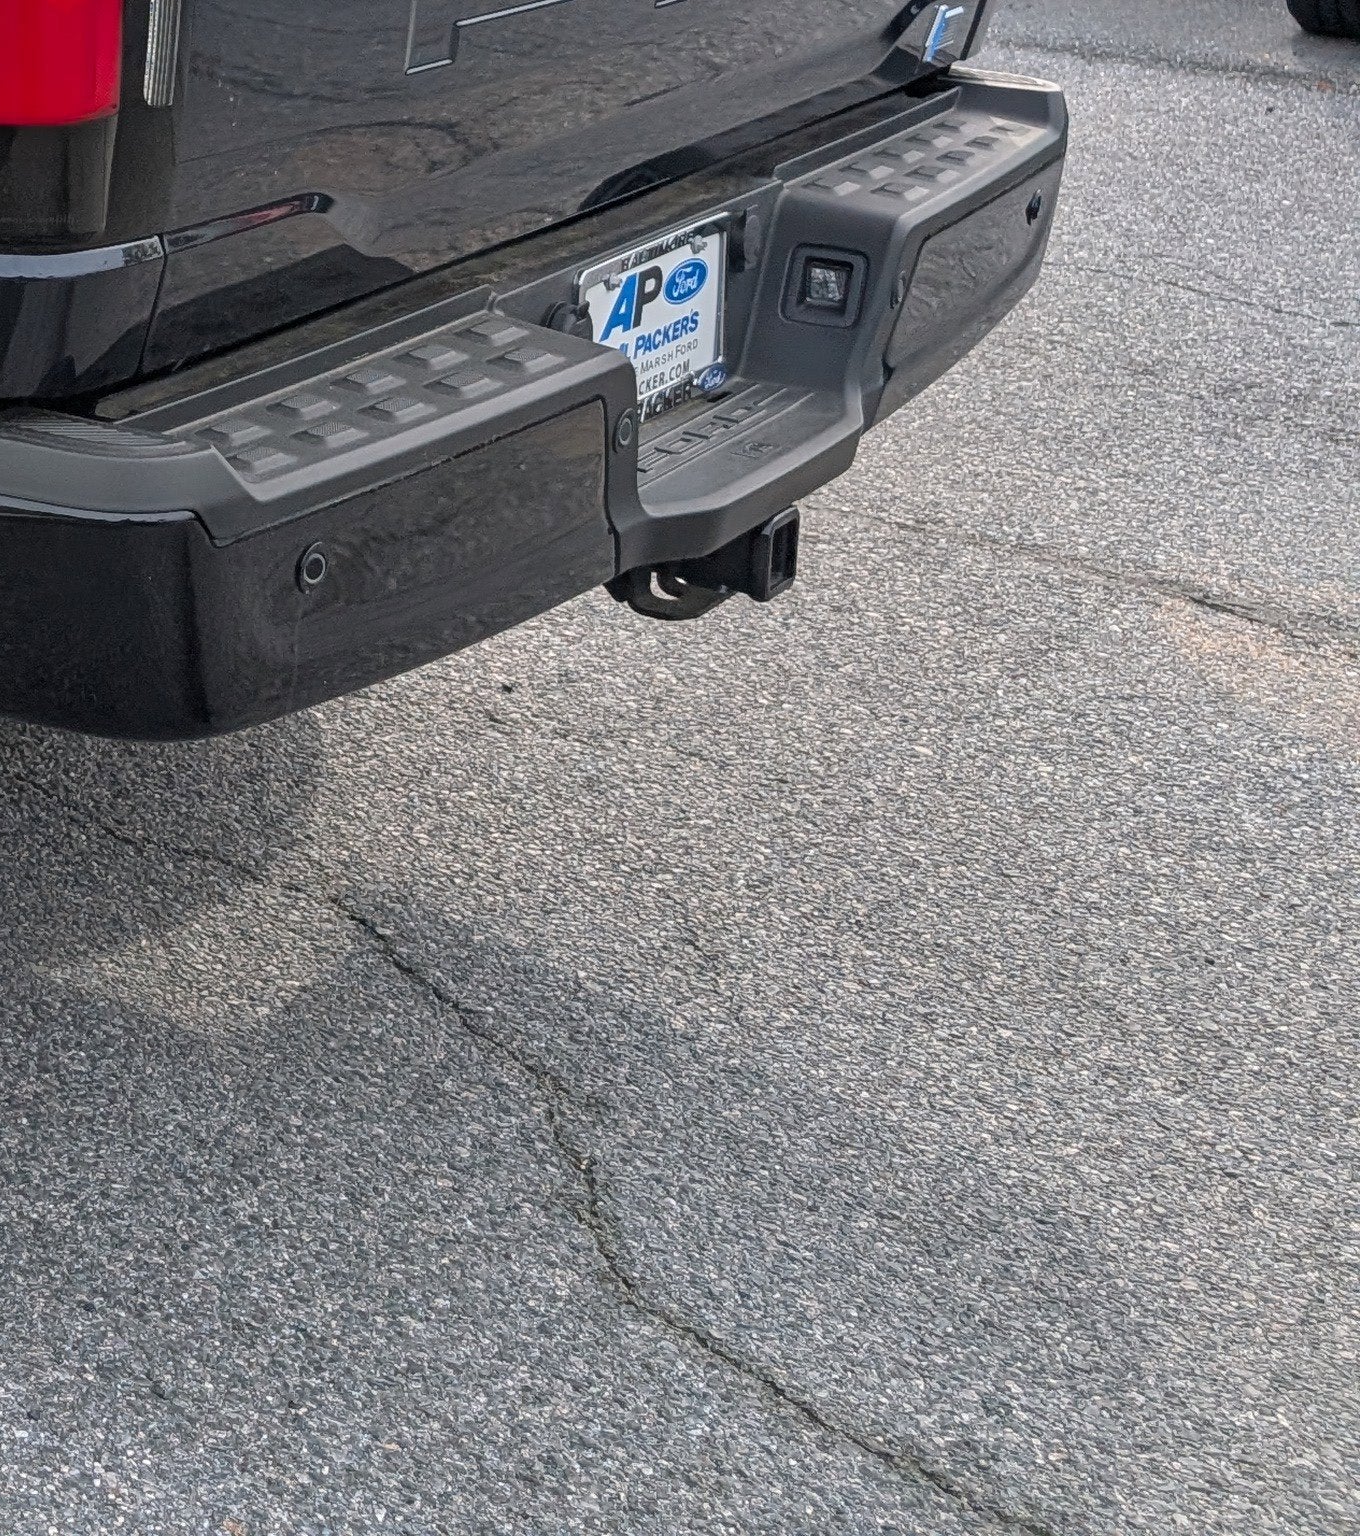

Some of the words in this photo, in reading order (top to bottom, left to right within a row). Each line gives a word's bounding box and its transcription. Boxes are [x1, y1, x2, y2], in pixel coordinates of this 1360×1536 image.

[599, 265, 664, 342] AP
[672, 266, 701, 299] Ford
[633, 308, 700, 360] PACKER'S
[640, 350, 674, 374] MARSH
[675, 338, 699, 359] FORD
[638, 358, 691, 396] CKER.COM
[637, 383, 692, 423] ACKER
